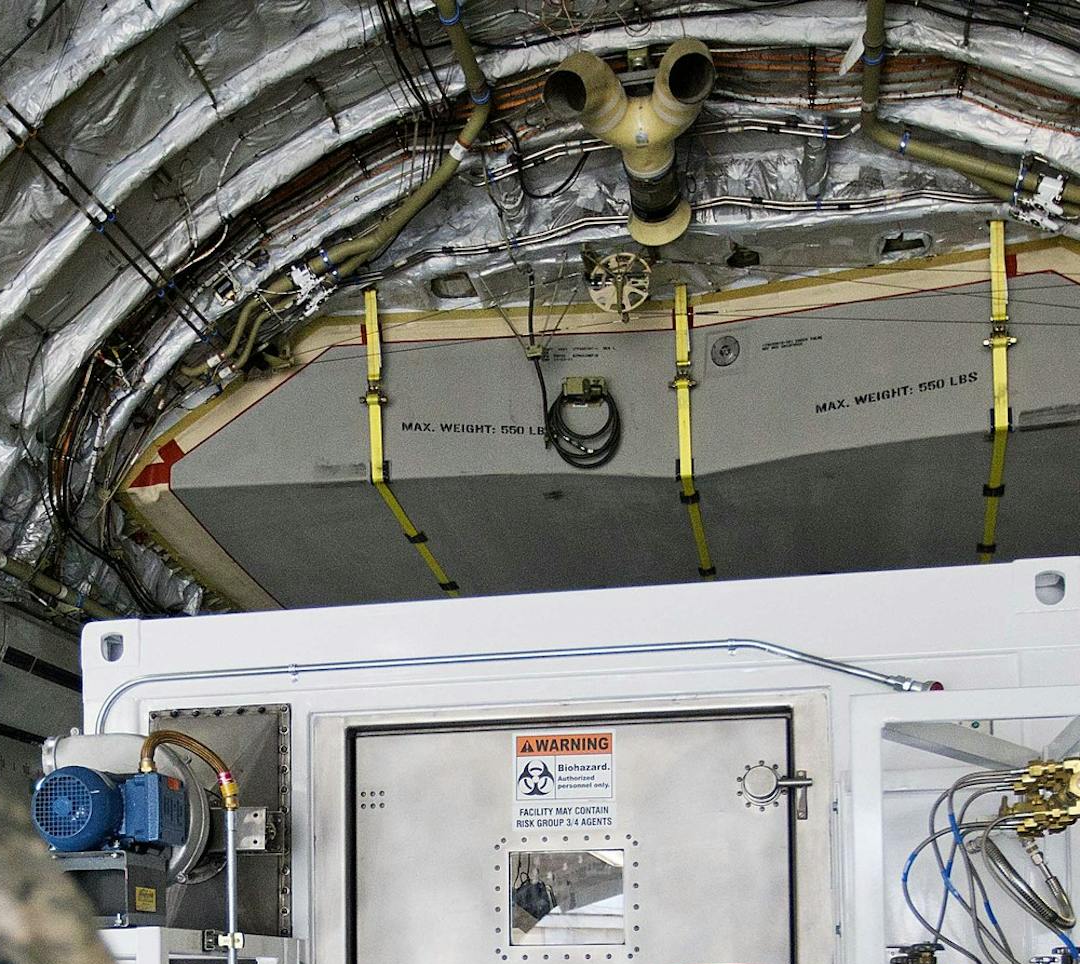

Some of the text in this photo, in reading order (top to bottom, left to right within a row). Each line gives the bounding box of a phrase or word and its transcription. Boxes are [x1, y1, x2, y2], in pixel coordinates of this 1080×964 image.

[815, 371, 979, 414] MAX. WEIGHT: 550 LBS
[401, 422, 546, 436] MAX. WEIGHT: 550 LB
[535, 737, 609, 752] WARNING
[557, 763, 611, 772] Biohazard.
[593, 782, 611, 790] only.
[519, 806, 609, 817] FACILITY MAY CONTAIN
[516, 819, 535, 828] RISK
[537, 818, 565, 828] GROUP
[581, 817, 613, 827] AGENTS
